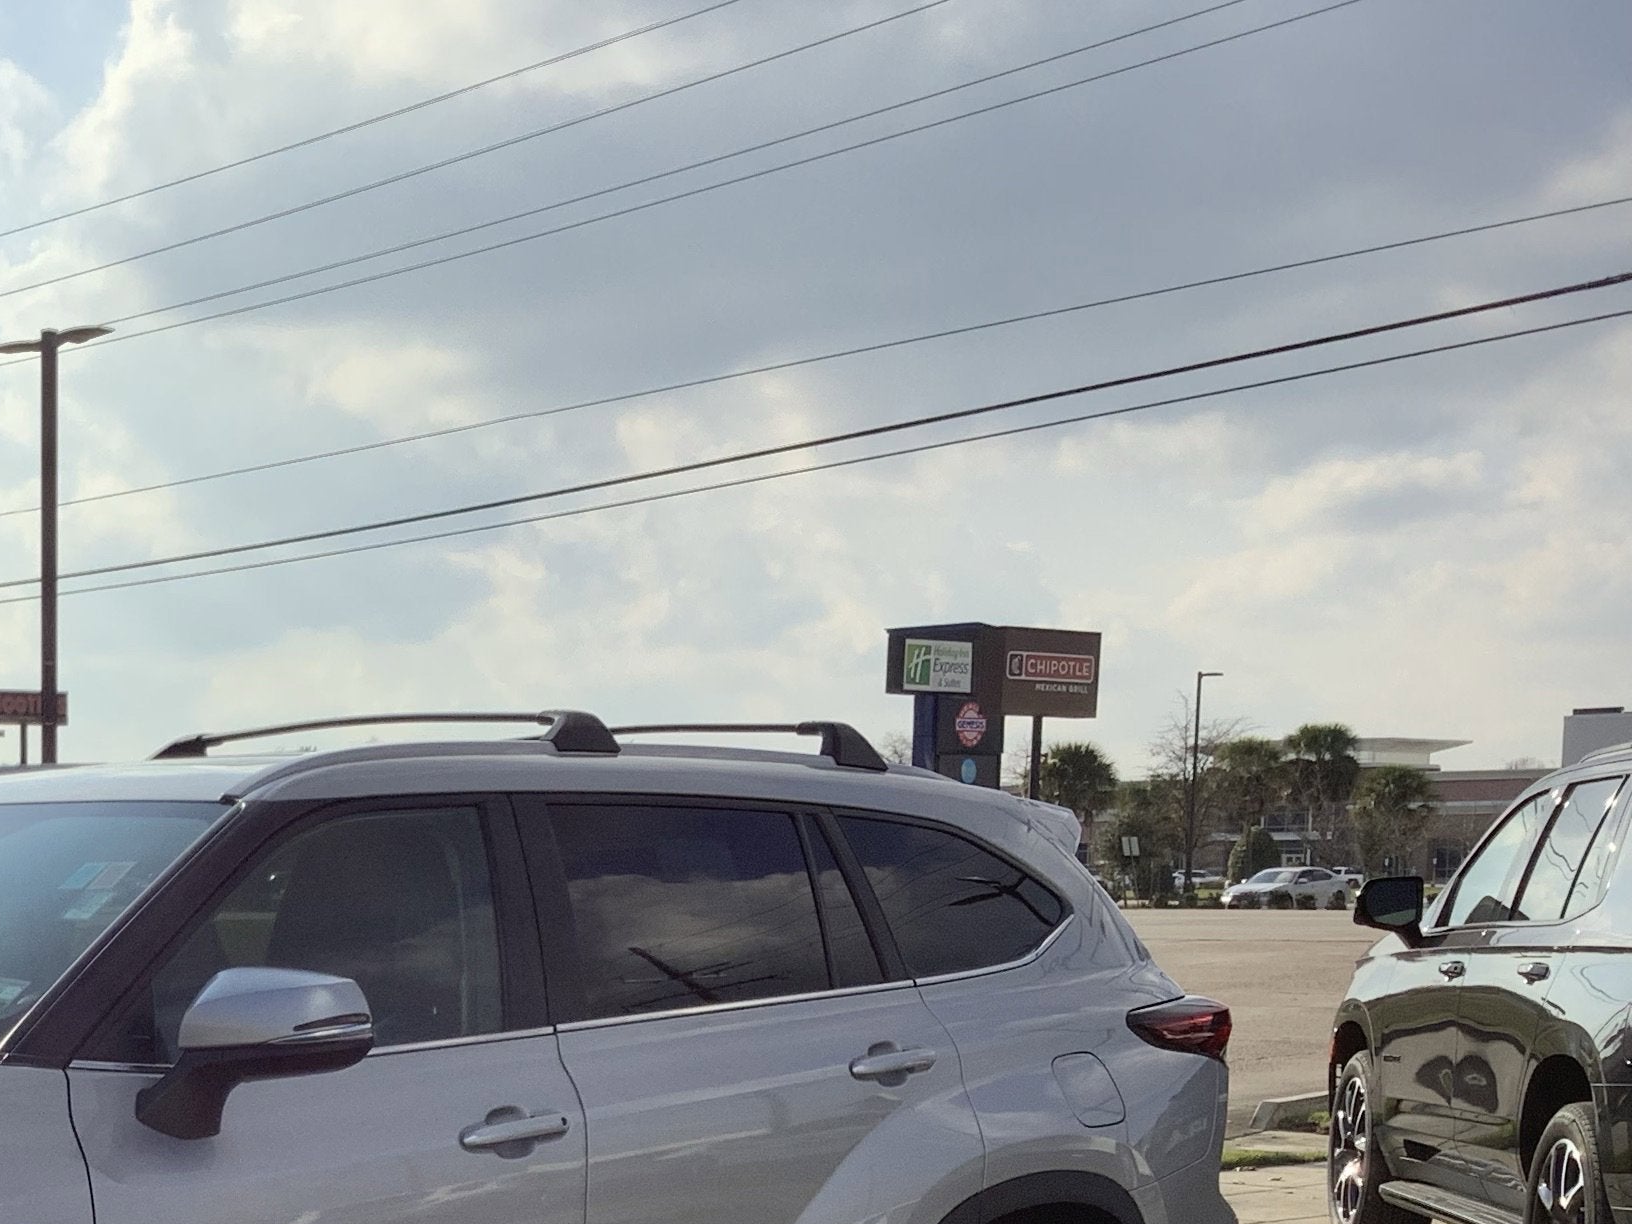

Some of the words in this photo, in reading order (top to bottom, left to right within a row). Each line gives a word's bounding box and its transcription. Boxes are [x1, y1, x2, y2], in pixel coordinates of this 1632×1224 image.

[933, 658, 969, 676] Express
[1028, 659, 1090, 675] CHIPOTLE
[1035, 684, 1067, 692] MEXICAN
[1069, 685, 1088, 694] GRILL
